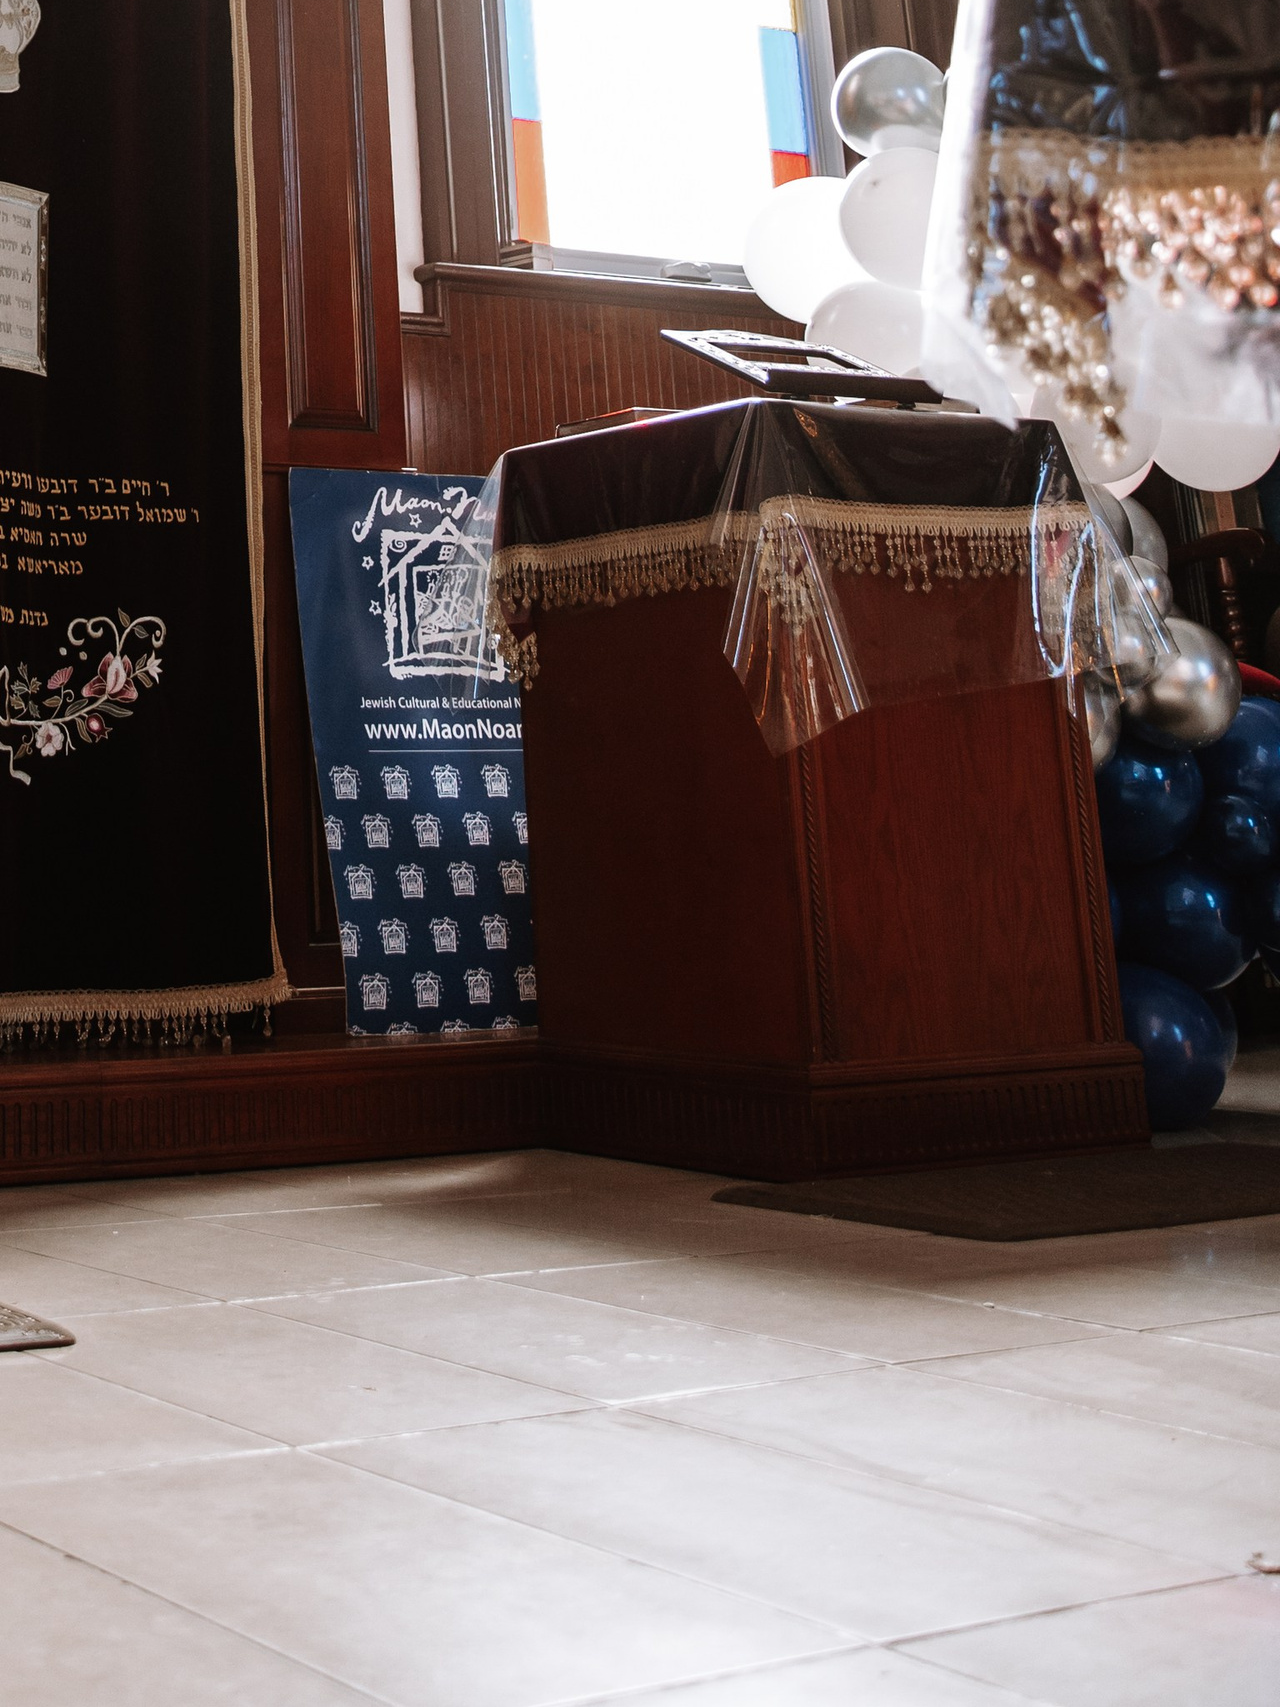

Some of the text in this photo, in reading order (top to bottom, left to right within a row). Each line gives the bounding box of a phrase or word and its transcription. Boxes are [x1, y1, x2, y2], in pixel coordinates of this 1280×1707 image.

[121, 479, 151, 497] חיים
[77, 505, 130, 521] דובער
[135, 500, 187, 524] שמואל
[49, 531, 87, 547] שרה
[359, 696, 396, 709] Jewish
[398, 696, 440, 709] Cultural
[441, 697, 450, 709] &
[451, 697, 512, 709] Educational
